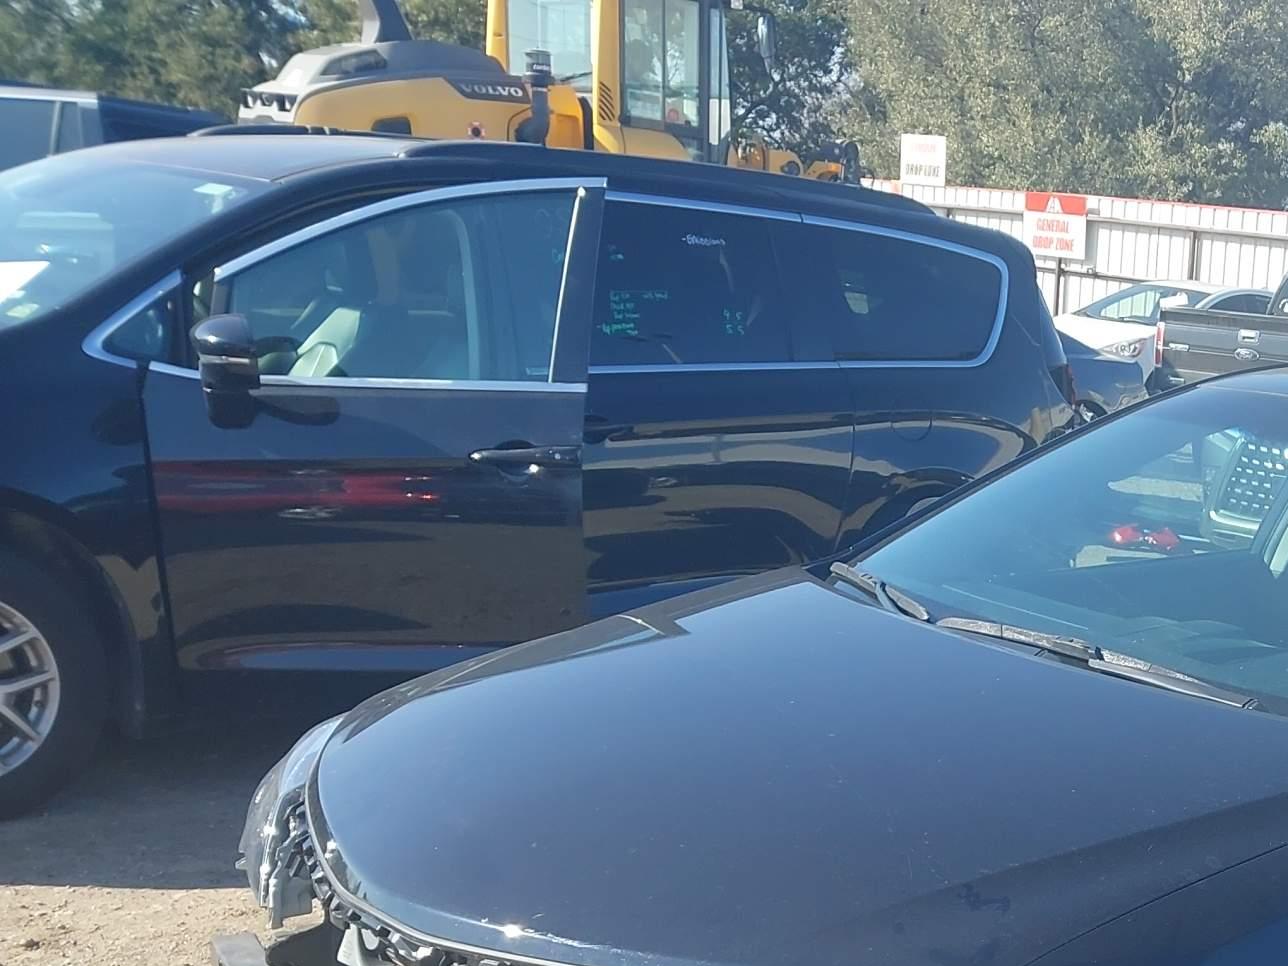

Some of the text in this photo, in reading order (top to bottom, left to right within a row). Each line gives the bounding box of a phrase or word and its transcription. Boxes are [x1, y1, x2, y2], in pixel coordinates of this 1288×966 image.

[460, 83, 523, 97] VOLVO
[1036, 217, 1069, 234] GENERAL
[1032, 237, 1075, 252] DROP ZONE
